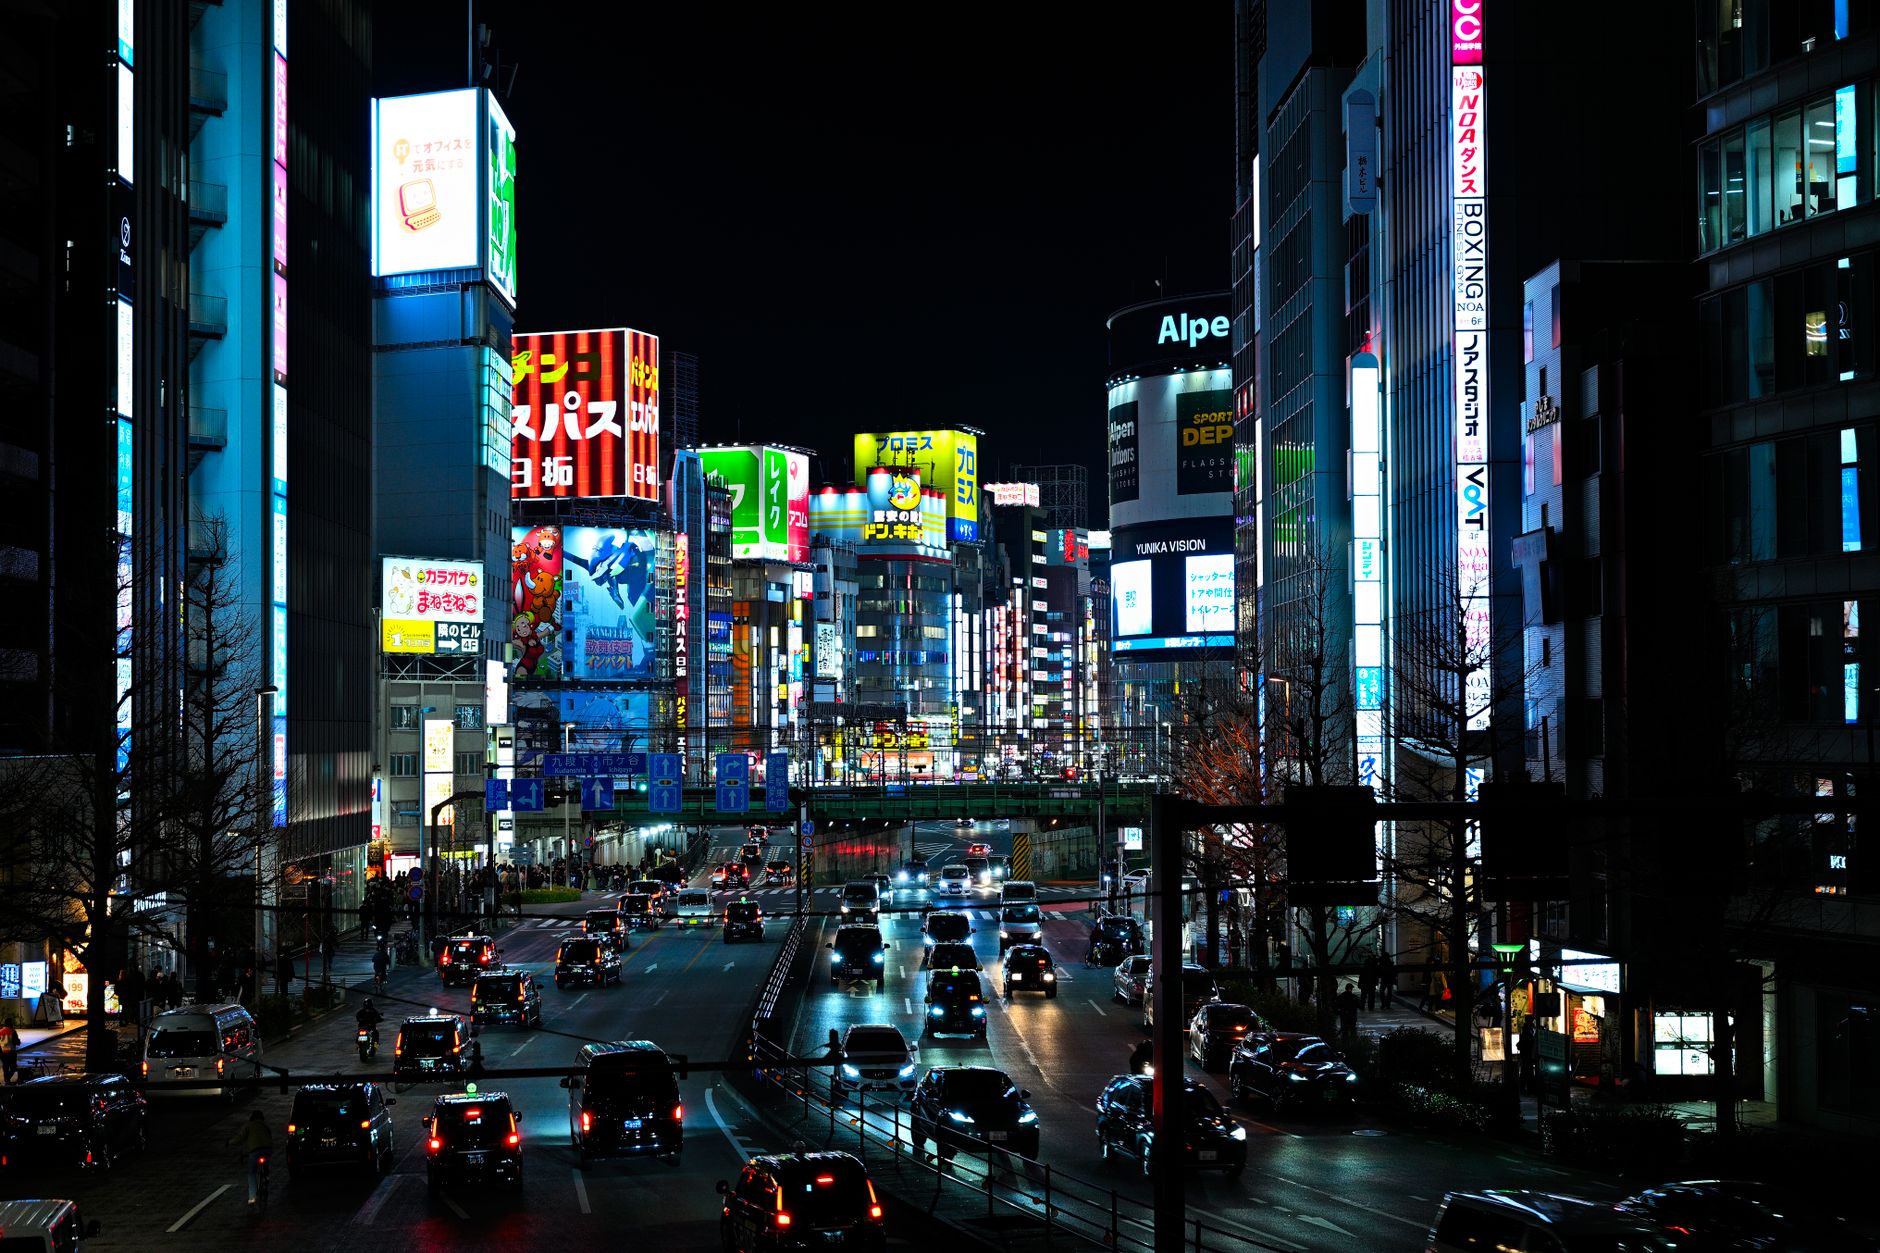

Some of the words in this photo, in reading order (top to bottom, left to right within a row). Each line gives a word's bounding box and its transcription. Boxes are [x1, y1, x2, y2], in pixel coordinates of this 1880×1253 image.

[1464, 203, 1484, 299] BOXING
[1456, 302, 1485, 312] NOA
[1471, 317, 1483, 326] 6F
[1157, 312, 1230, 348] Alpe
[1109, 421, 1135, 446] Alpen
[875, 435, 934, 452] プロミス
[770, 455, 780, 530] レイク
[789, 510, 808, 528] アコム
[1136, 542, 1168, 555] YUNIKA
[1169, 539, 1206, 552] VISION
[425, 569, 470, 586] カラオケ
[417, 590, 477, 615] まねきねこ
[437, 623, 480, 638] 隣のビル
[463, 640, 478, 650] 4F
[586, 655, 633, 670] インパクト
[552, 755, 589, 767] 九段下
[608, 766, 633, 774] Ichigaya
